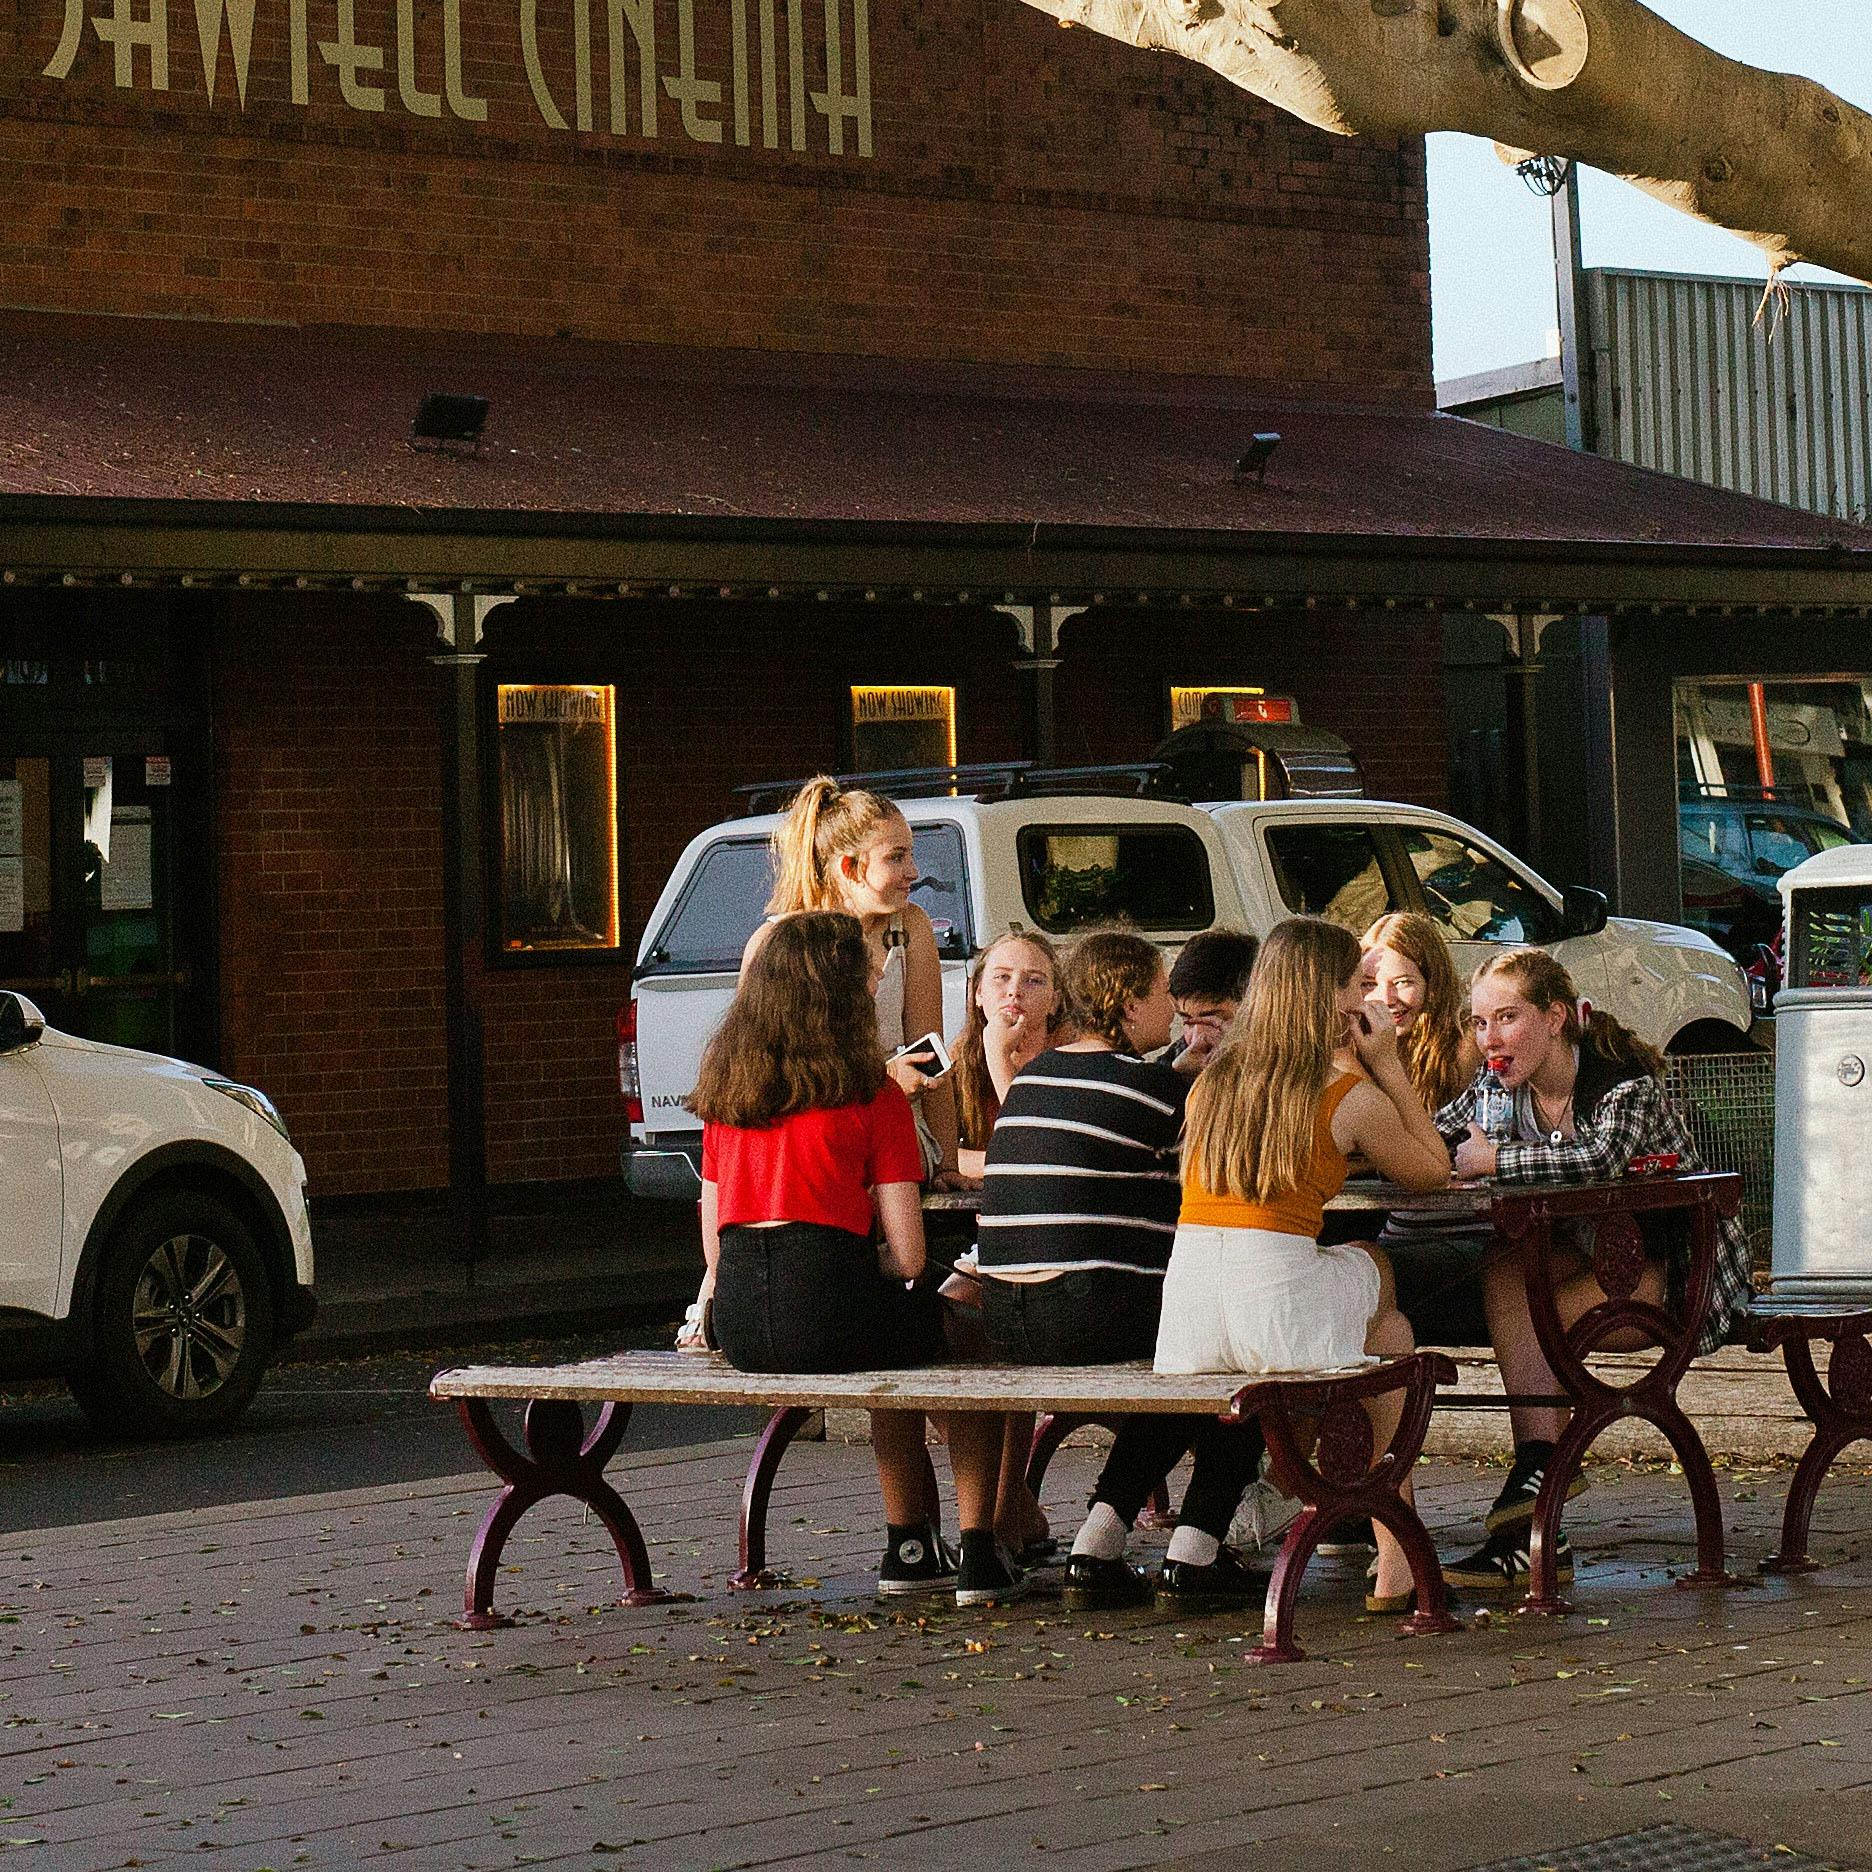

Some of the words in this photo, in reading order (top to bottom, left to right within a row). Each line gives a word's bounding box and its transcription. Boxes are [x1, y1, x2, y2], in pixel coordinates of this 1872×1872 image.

[506, 689, 537, 718] NOW
[543, 689, 600, 718] SHOWING
[859, 690, 887, 718] NOW
[891, 690, 944, 716] SHOWING
[1178, 692, 1204, 716] COM
